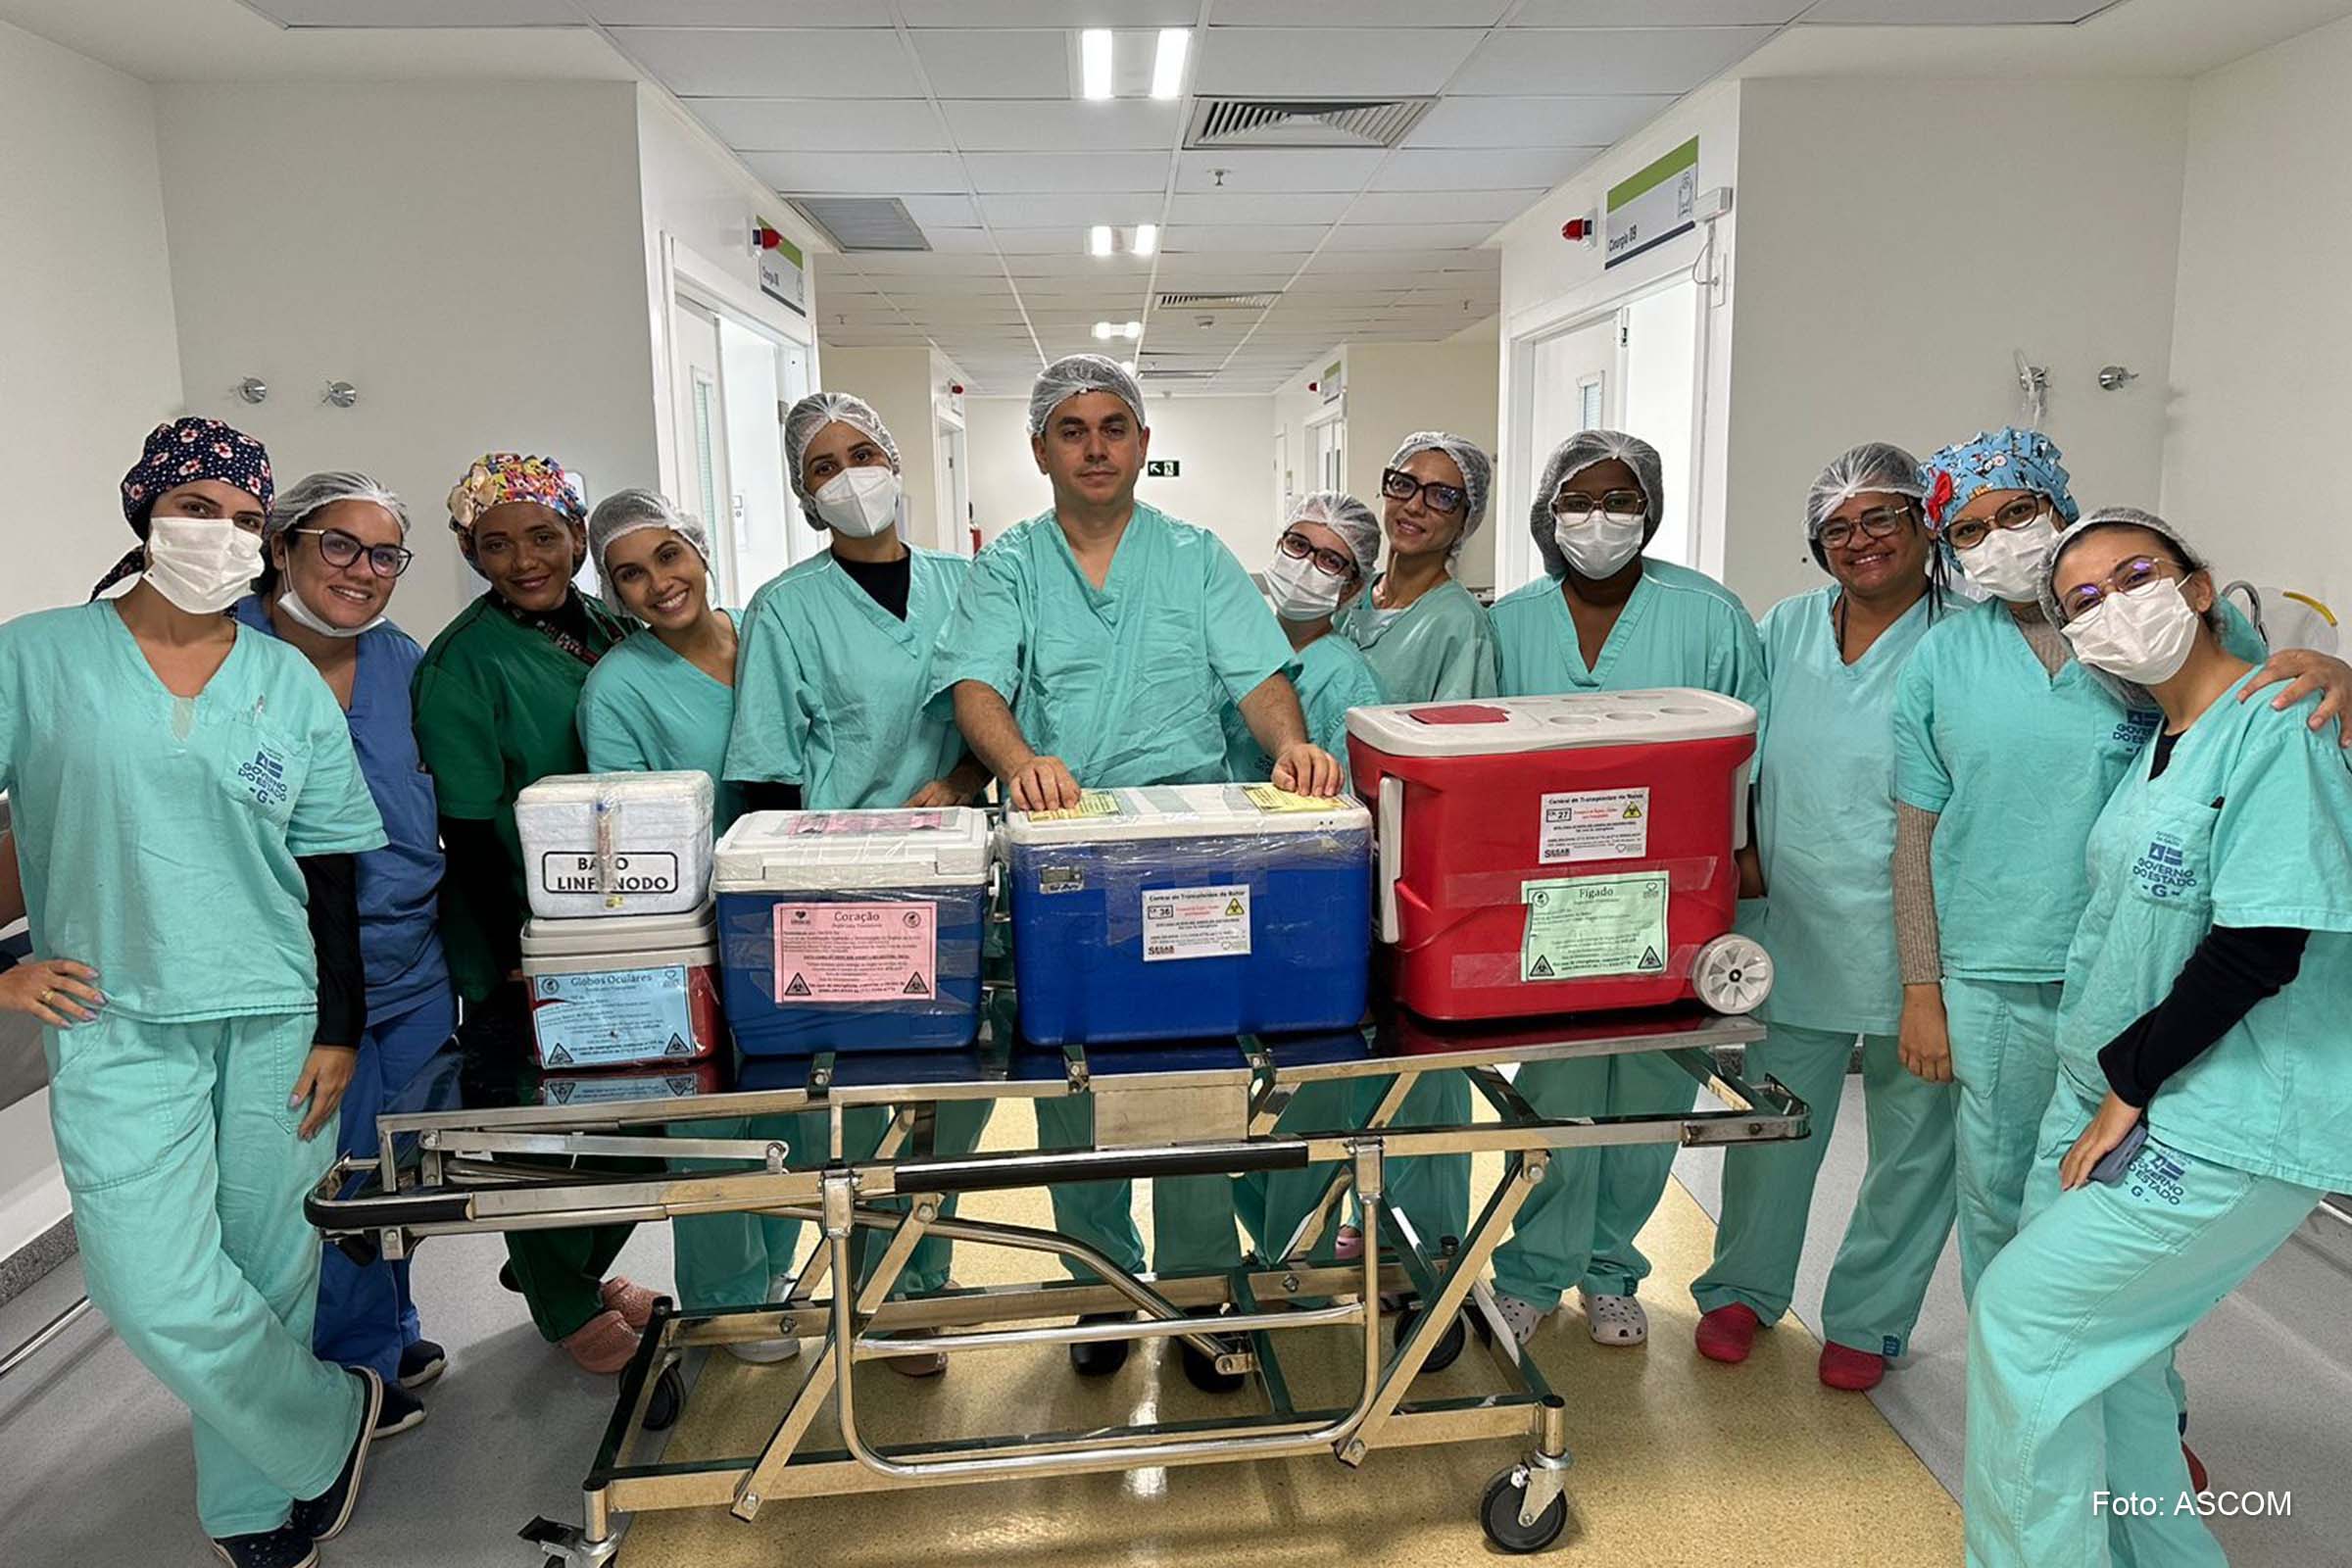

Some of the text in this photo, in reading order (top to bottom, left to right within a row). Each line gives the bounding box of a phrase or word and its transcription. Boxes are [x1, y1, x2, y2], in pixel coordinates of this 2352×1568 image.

[2132, 865, 2197, 888] DO ESTADO
[2137, 857, 2194, 878] GOVERNO
[557, 876, 668, 891] LINFNODO
[1579, 886, 1614, 899] Fígado
[834, 910, 880, 923] Coração
[570, 976, 606, 987] Globos
[607, 973, 653, 985] Oculares
[2136, 1156, 2184, 1197] GOVERNO
[2135, 1169, 2180, 1205] ESTADO
